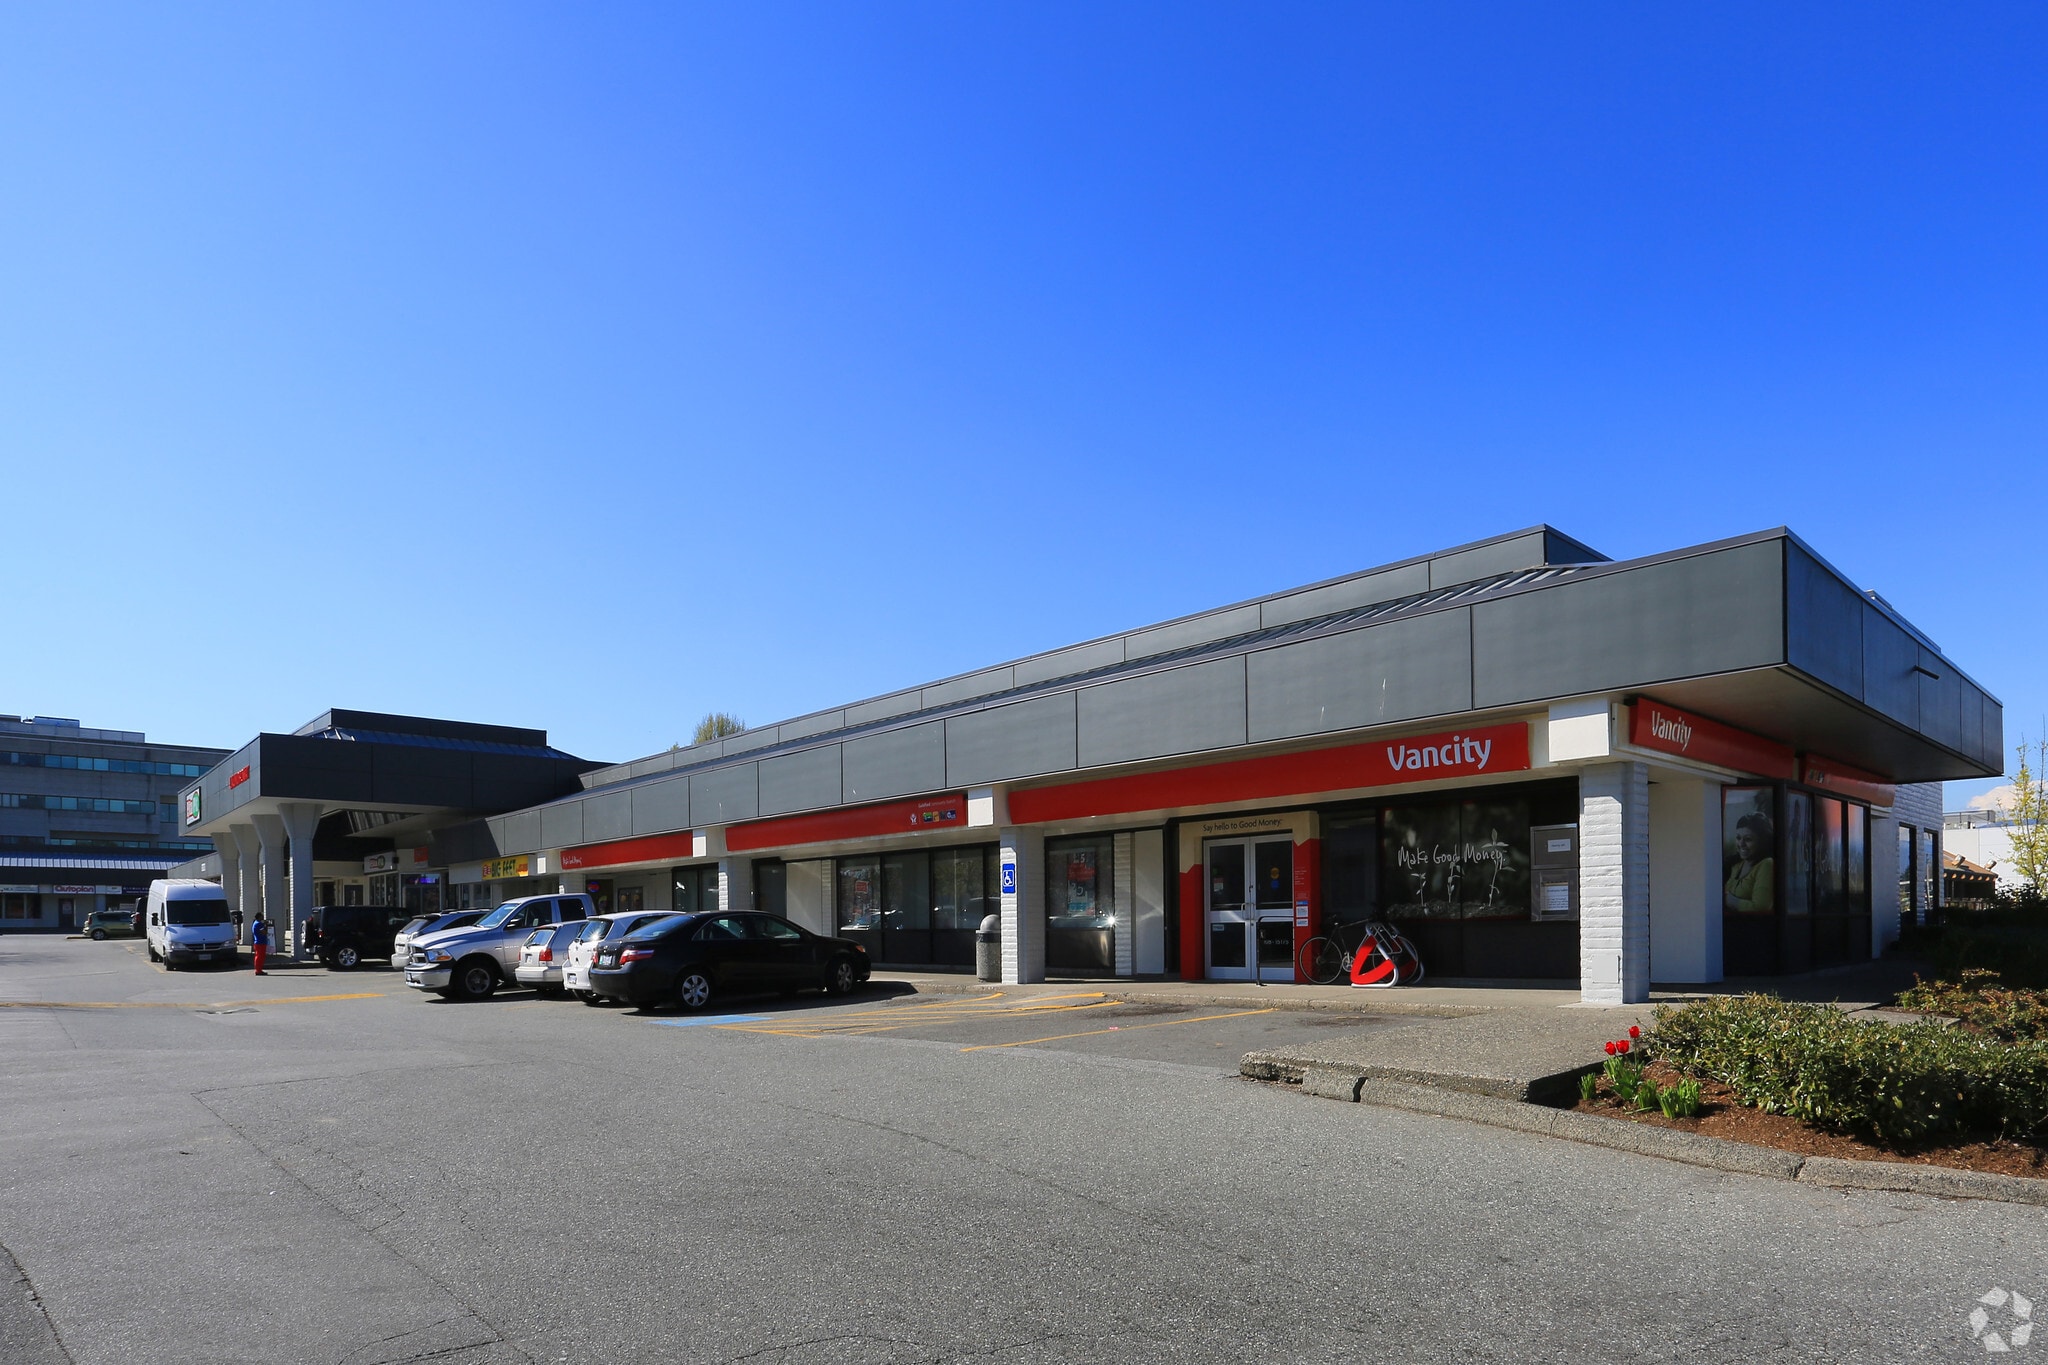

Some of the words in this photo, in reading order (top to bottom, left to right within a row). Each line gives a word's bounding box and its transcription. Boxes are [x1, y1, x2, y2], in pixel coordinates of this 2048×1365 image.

[1652, 710, 1692, 752] Vancity
[1387, 735, 1492, 771] Vancity
[1203, 824, 1214, 833] Say
[1214, 822, 1230, 831] hello
[1231, 821, 1238, 829] to
[1239, 820, 1257, 829] Good
[1398, 846, 1429, 870] Make
[1433, 844, 1460, 864] Good
